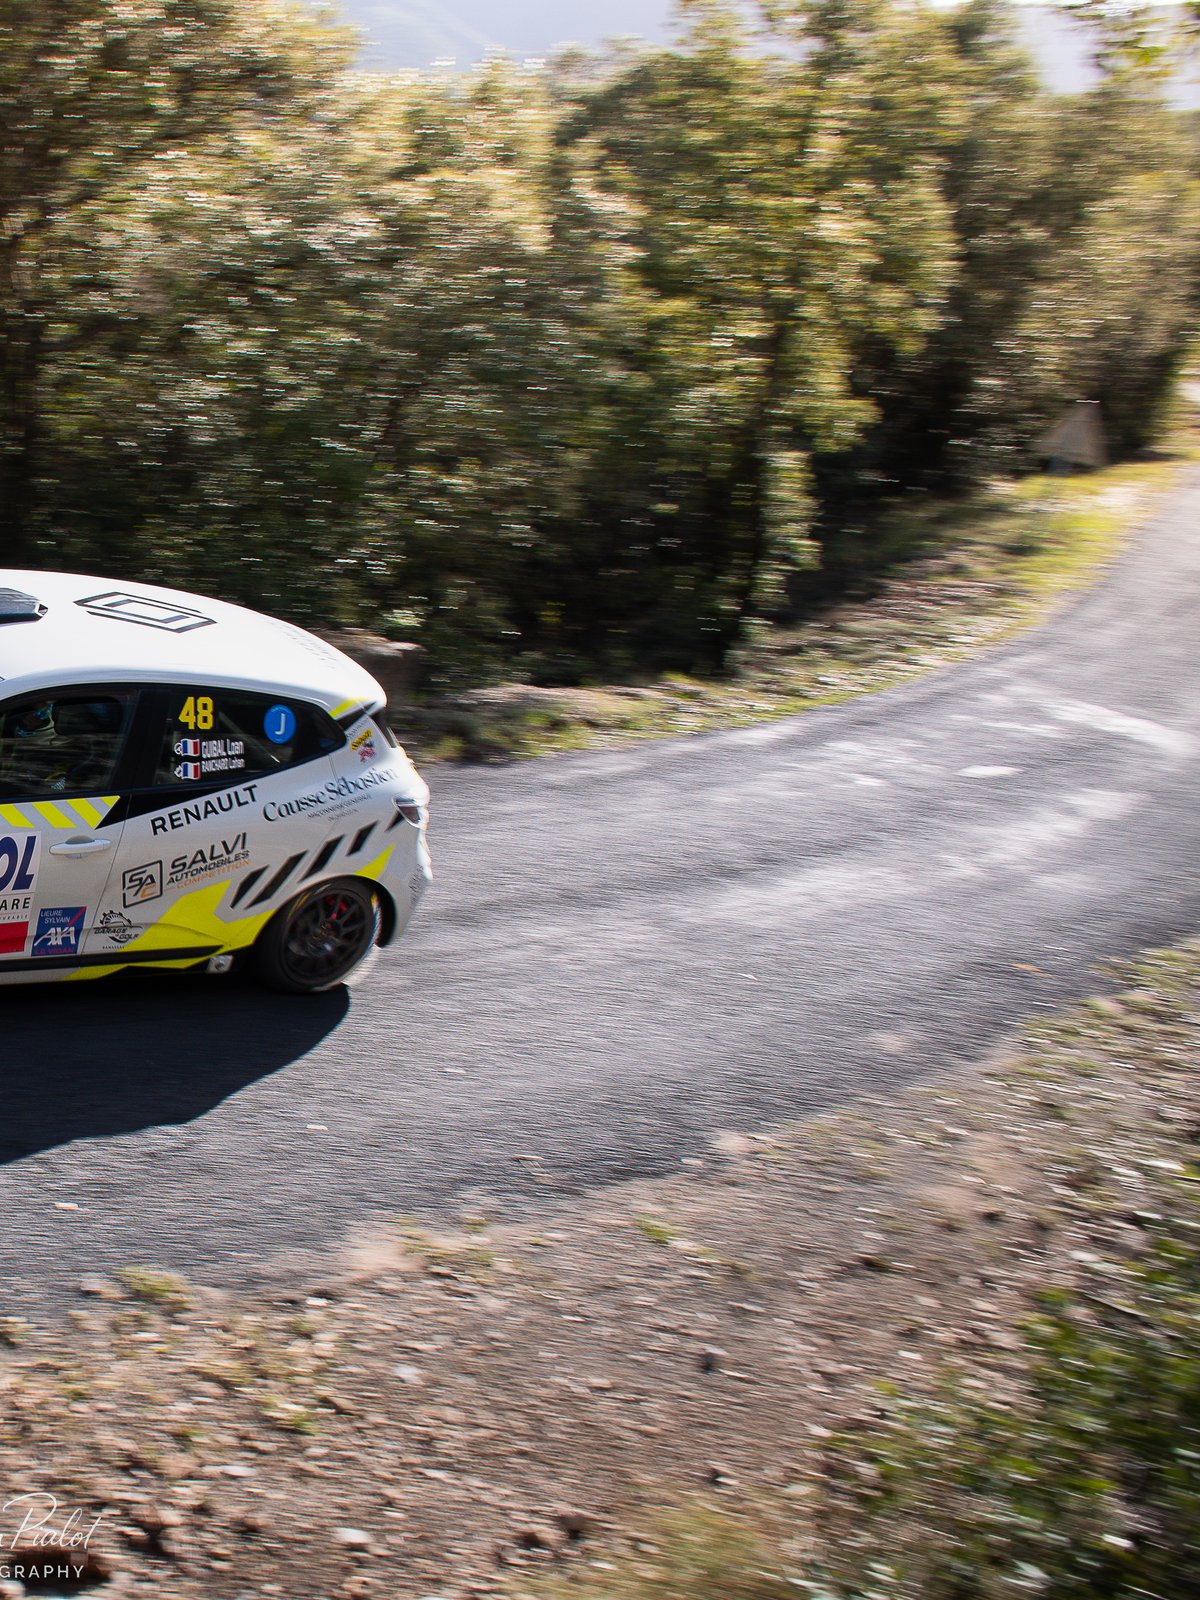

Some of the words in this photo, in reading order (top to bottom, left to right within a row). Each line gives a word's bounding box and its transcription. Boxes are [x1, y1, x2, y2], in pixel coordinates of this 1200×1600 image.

[179, 697, 213, 729] 48
[275, 713, 286, 735] J
[152, 785, 258, 836] RENAULT
[263, 791, 325, 822] Causse
[166, 850, 250, 886] AUTOMOBILES
[169, 832, 247, 876] SALVI
[33, 926, 76, 947] AXA
[44, 917, 70, 925] SYLVAIN
